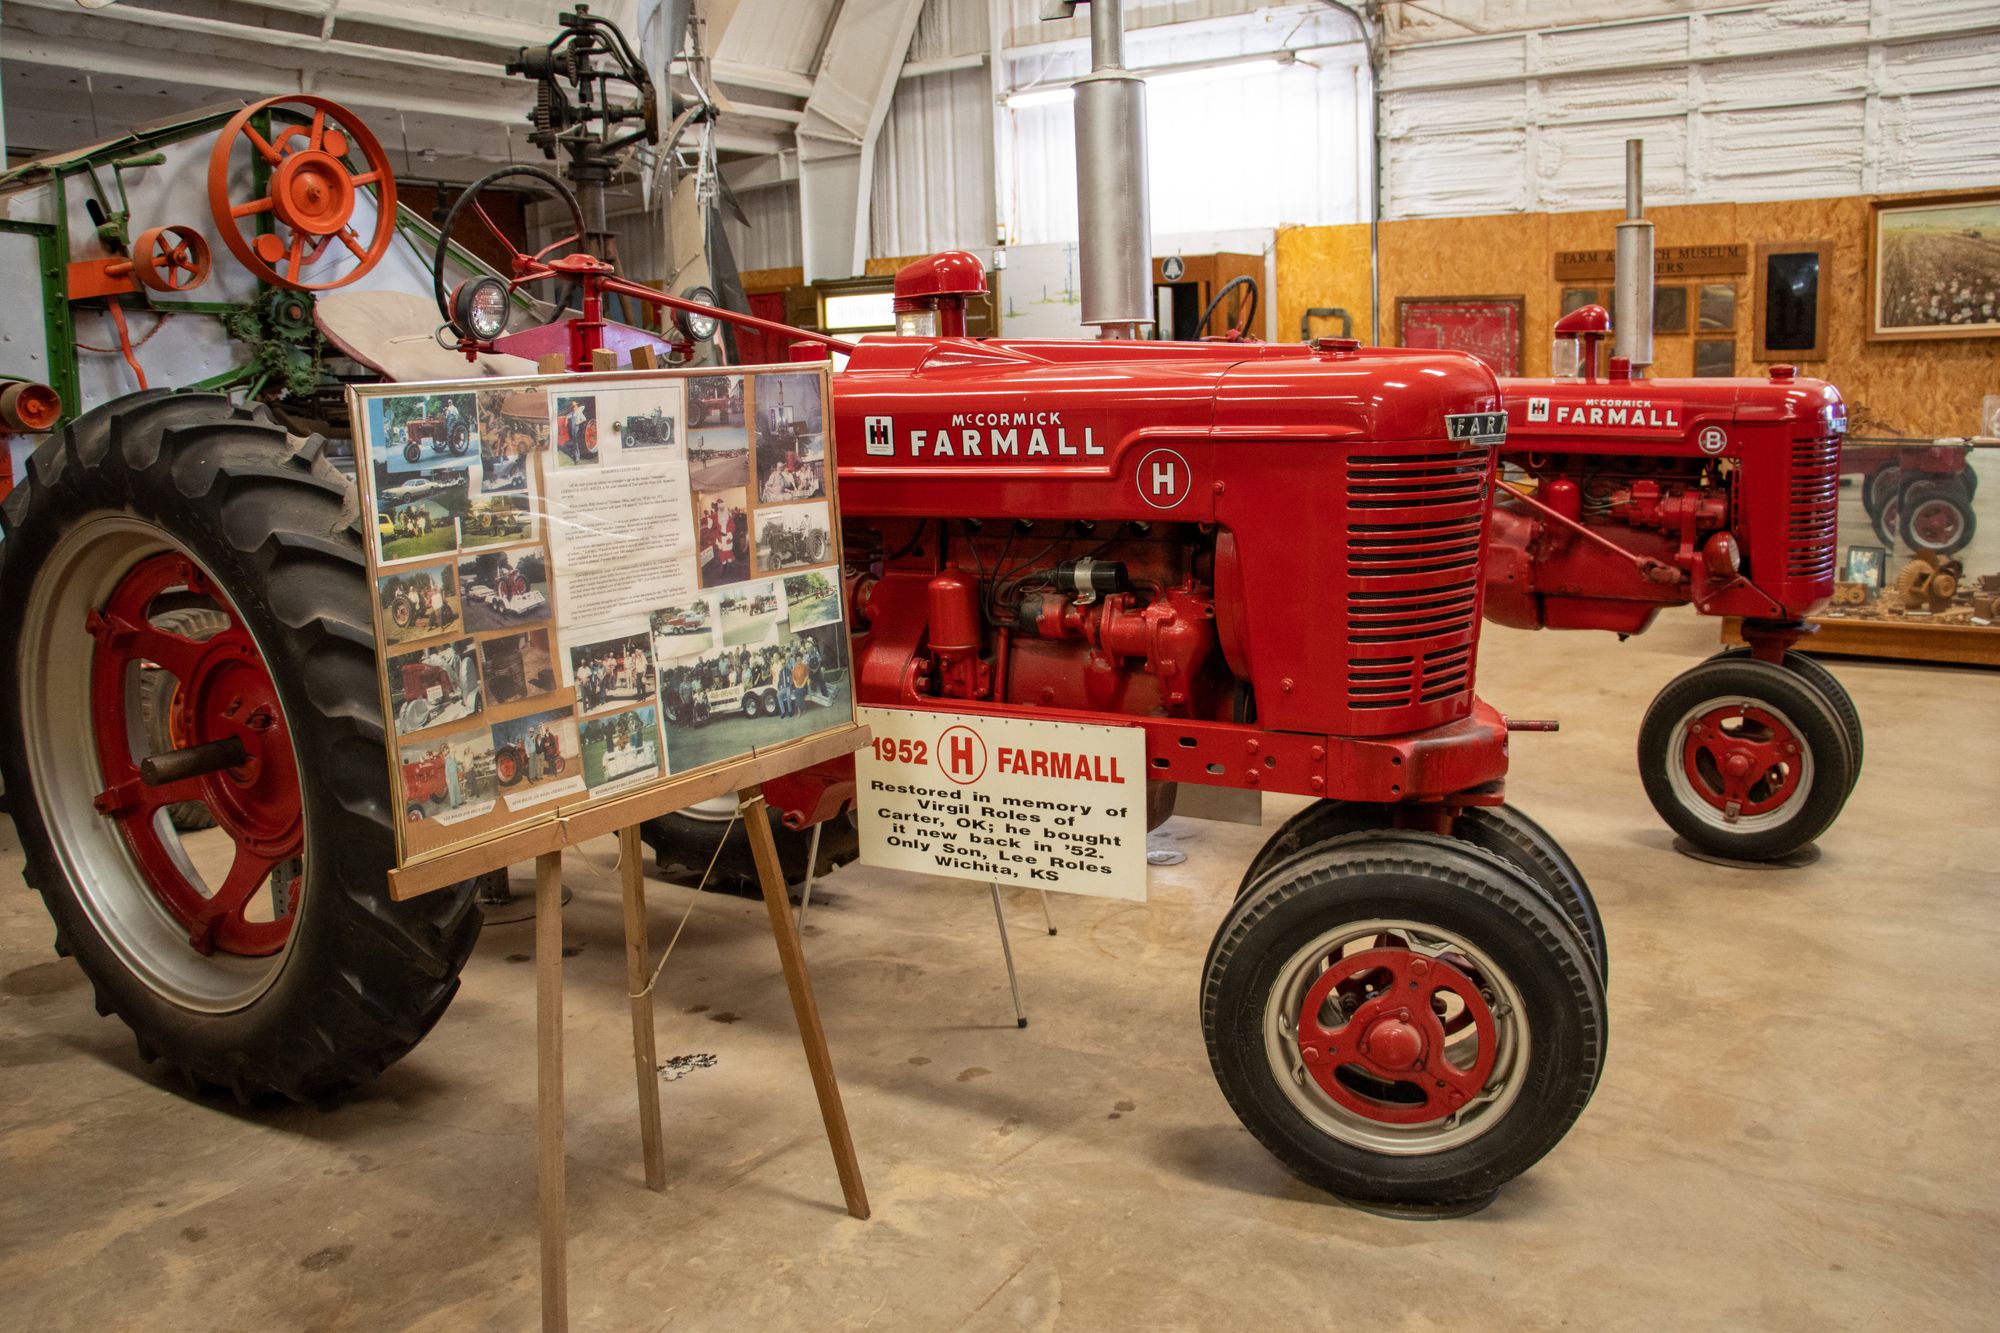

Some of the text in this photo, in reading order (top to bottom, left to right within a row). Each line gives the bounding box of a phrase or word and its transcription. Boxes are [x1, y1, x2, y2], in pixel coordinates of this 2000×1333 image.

[1563, 253, 1598, 264] FARM
[1679, 246, 1740, 259] MUSEUM
[1557, 407, 1679, 427] FARMALL
[910, 427, 1105, 457] FARMALL
[1706, 431, 1721, 449] B
[1152, 463, 1175, 495] H
[872, 735, 1125, 784] 1952 H FARMALL
[871, 780, 1128, 818] Restored in memory of
[917, 799, 1076, 827] Virgil Roles of
[878, 808, 1122, 847] Carter, OK; he bought
[892, 823, 907, 834] it
[916, 828, 958, 841] new
[970, 832, 1021, 849] back
[1034, 840, 1053, 852] in
[886, 836, 1112, 874] Only Son, Lee Roles
[935, 855, 1060, 881] Wichita, KS
